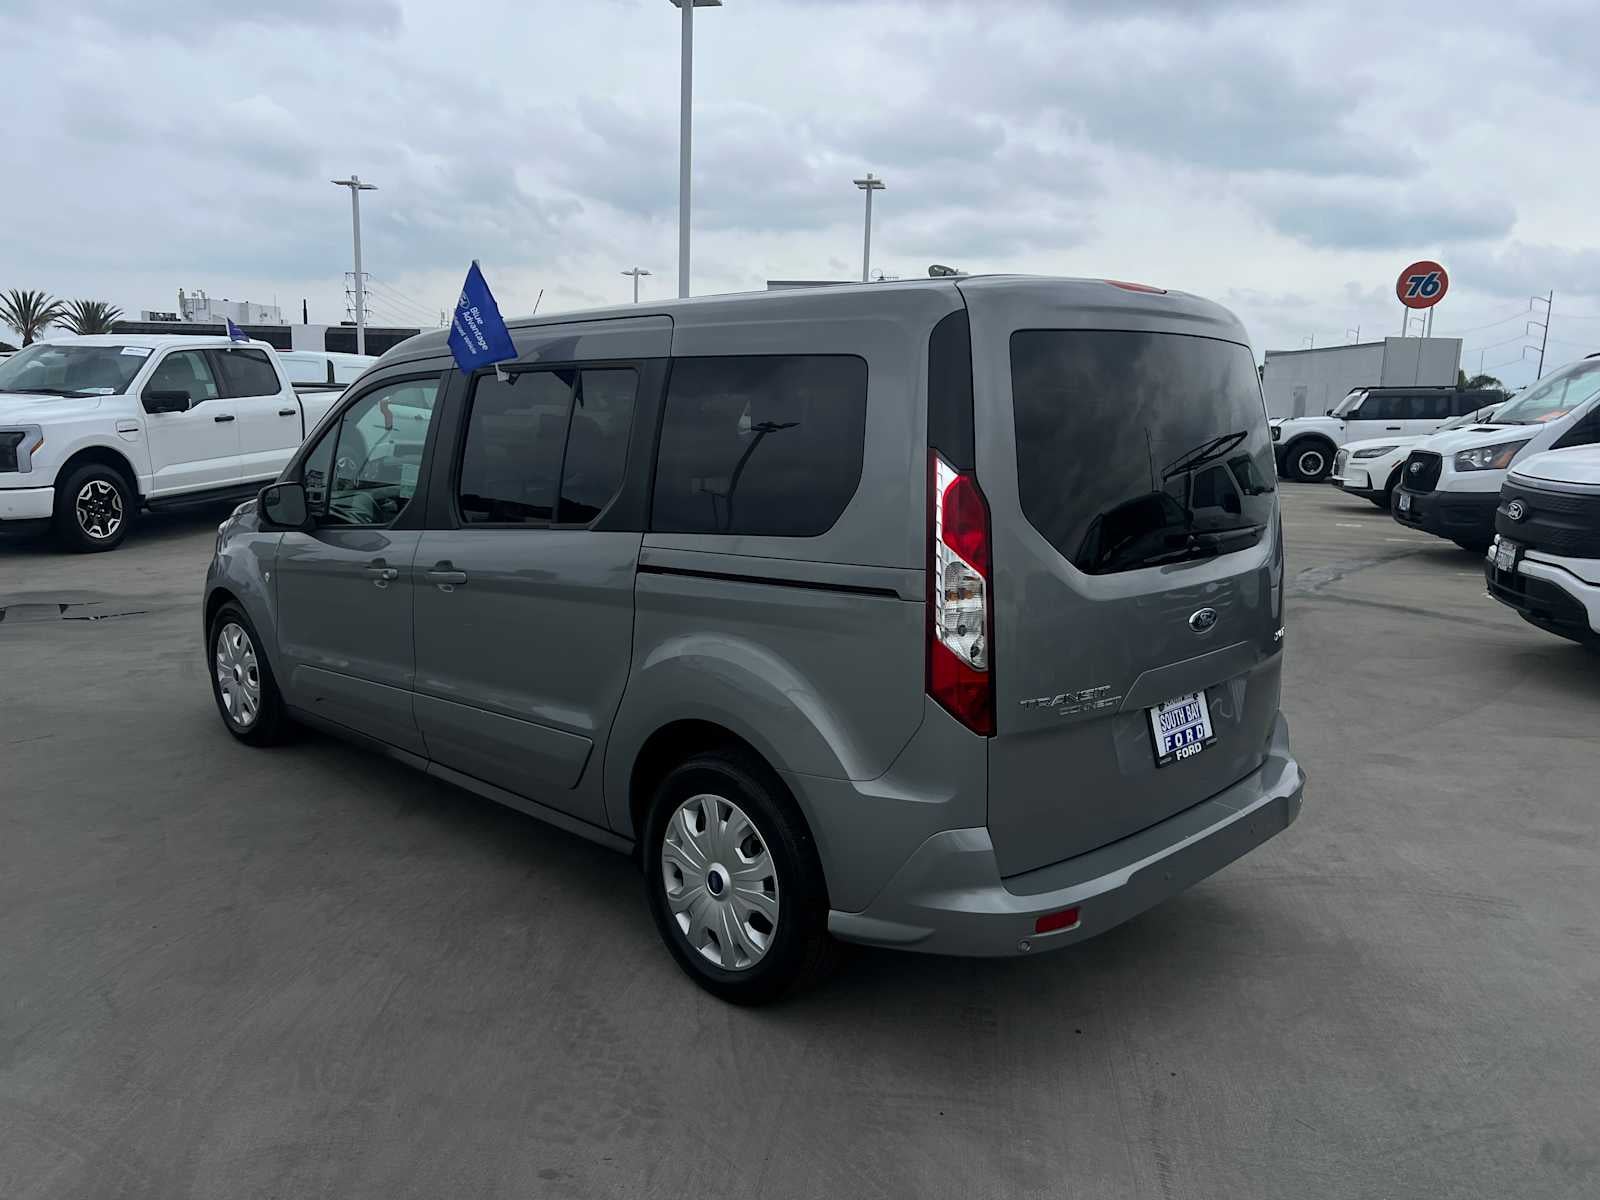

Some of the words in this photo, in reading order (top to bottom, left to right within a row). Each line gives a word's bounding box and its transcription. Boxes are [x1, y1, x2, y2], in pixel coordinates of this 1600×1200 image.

[1405, 271, 1441, 298] 76
[470, 306, 484, 325] Blue
[462, 311, 489, 351] Advantage
[1160, 706, 1187, 732] SOUTH
[1185, 701, 1201, 721] BAY
[1165, 724, 1204, 751] FORD
[1176, 742, 1202, 761] FORD
